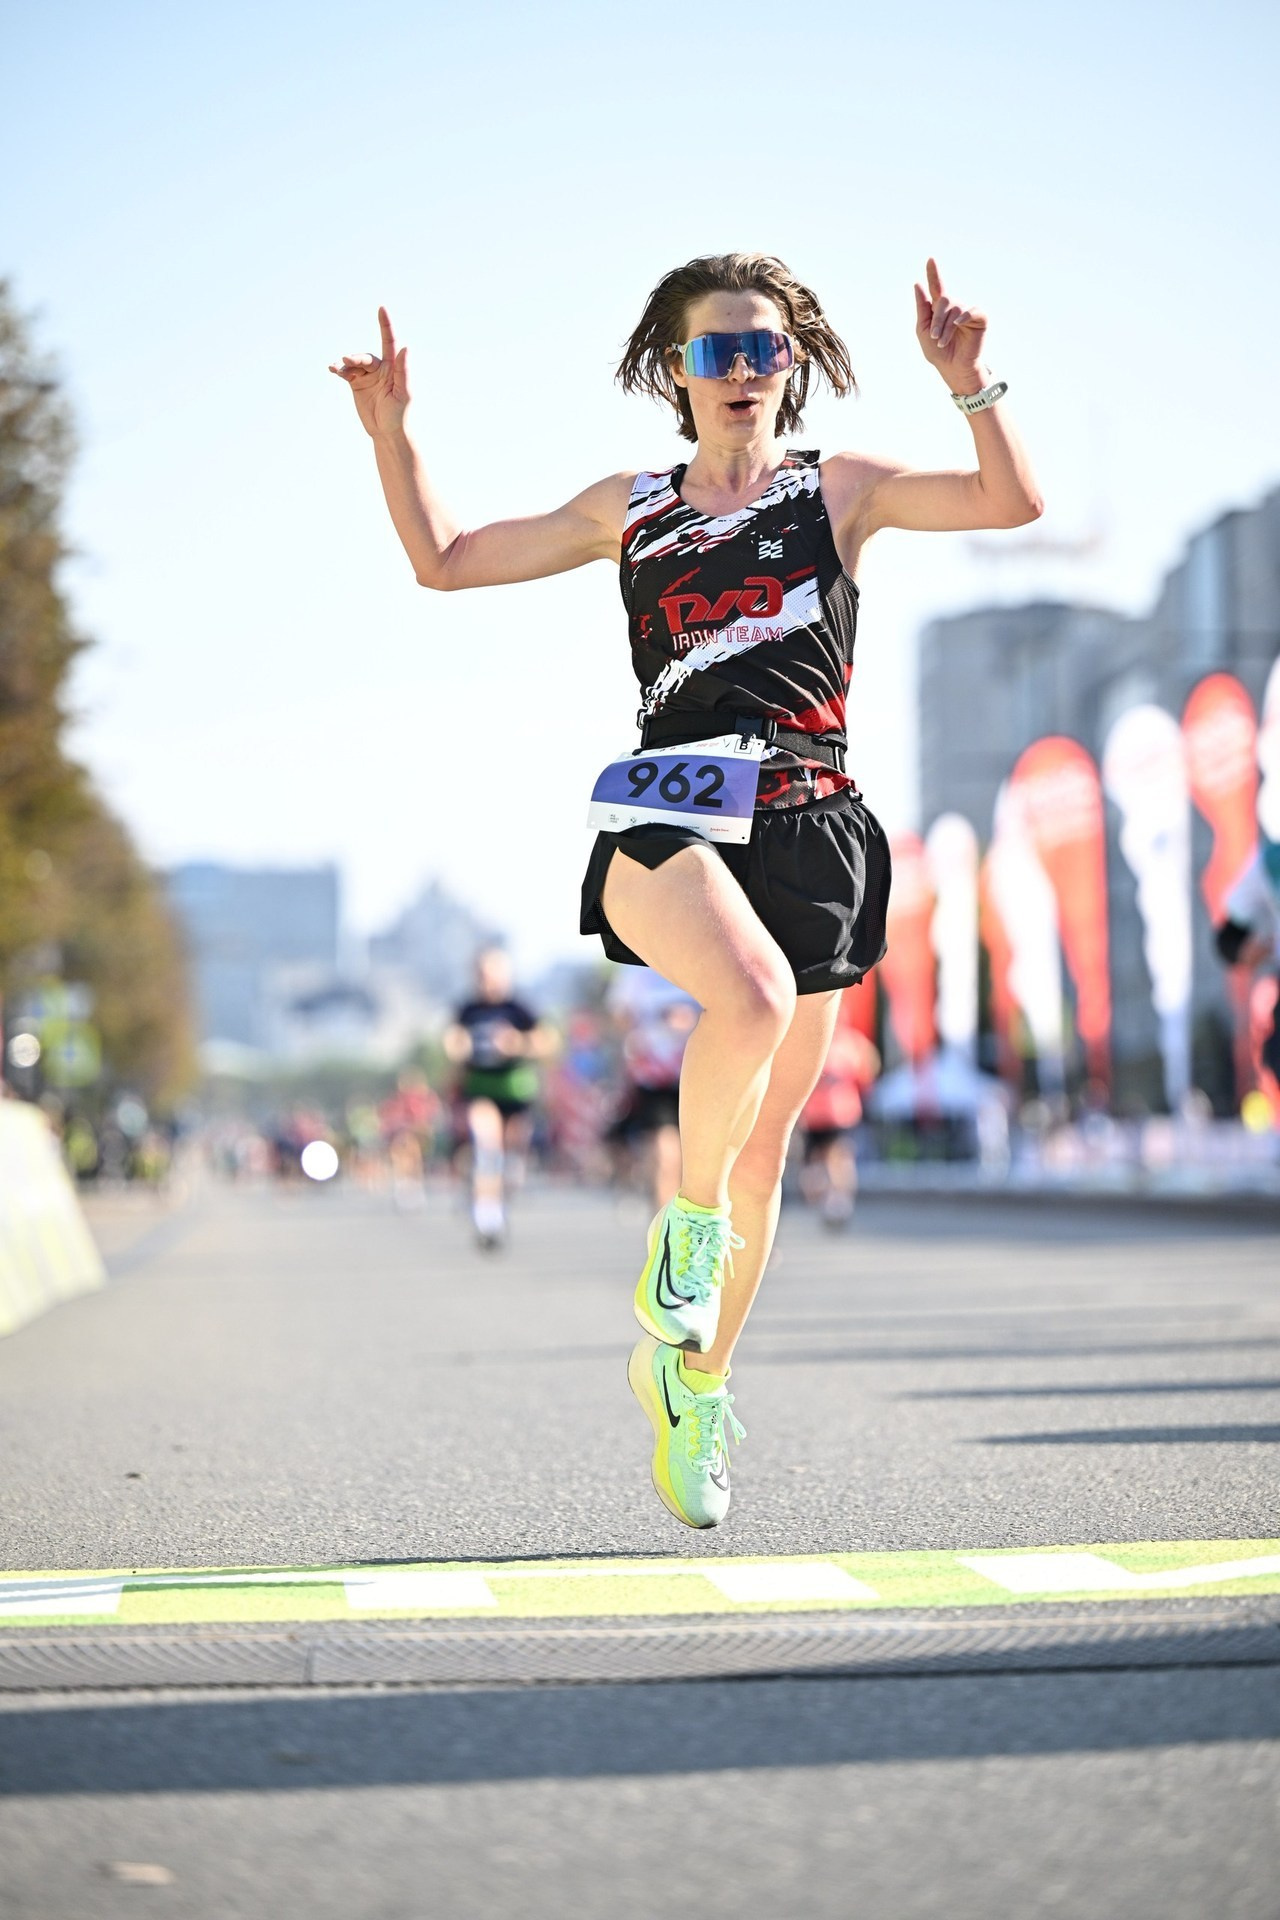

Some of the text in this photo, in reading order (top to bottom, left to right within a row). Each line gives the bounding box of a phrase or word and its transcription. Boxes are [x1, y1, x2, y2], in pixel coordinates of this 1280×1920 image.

[672, 626, 784, 651] IRON TEAM
[627, 761, 725, 808] 962
